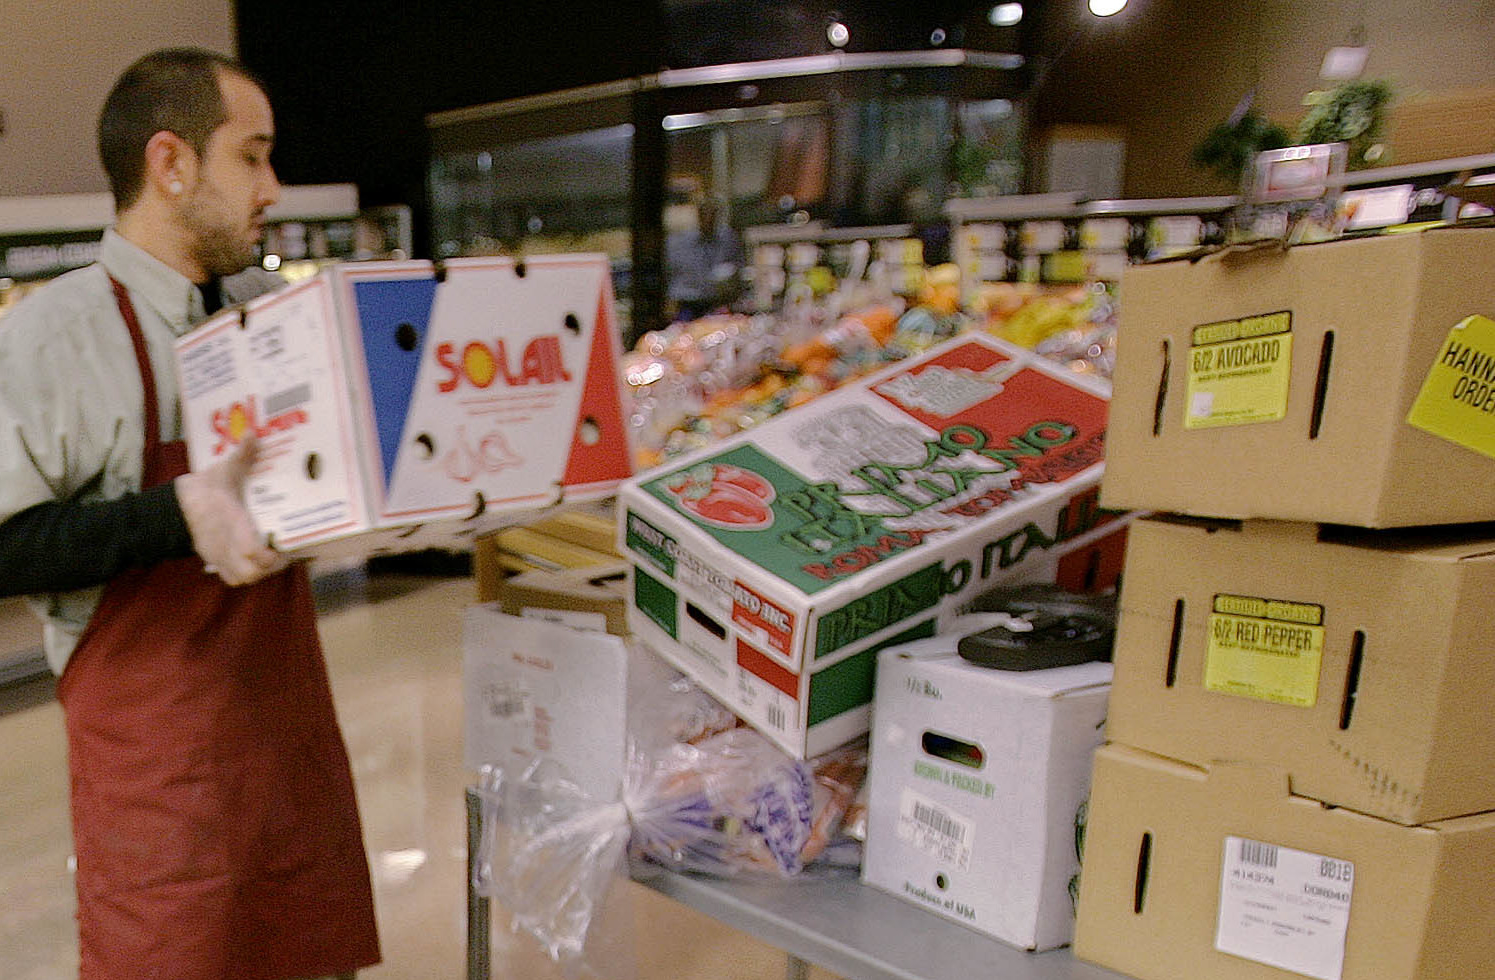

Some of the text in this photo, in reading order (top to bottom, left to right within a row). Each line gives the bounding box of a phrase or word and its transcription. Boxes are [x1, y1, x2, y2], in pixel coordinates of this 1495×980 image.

[1217, 339, 1281, 370] AVOCADO
[1442, 341, 1495, 386] HANN
[1236, 621, 1261, 643] RED
[1264, 625, 1314, 651] PEPPER
